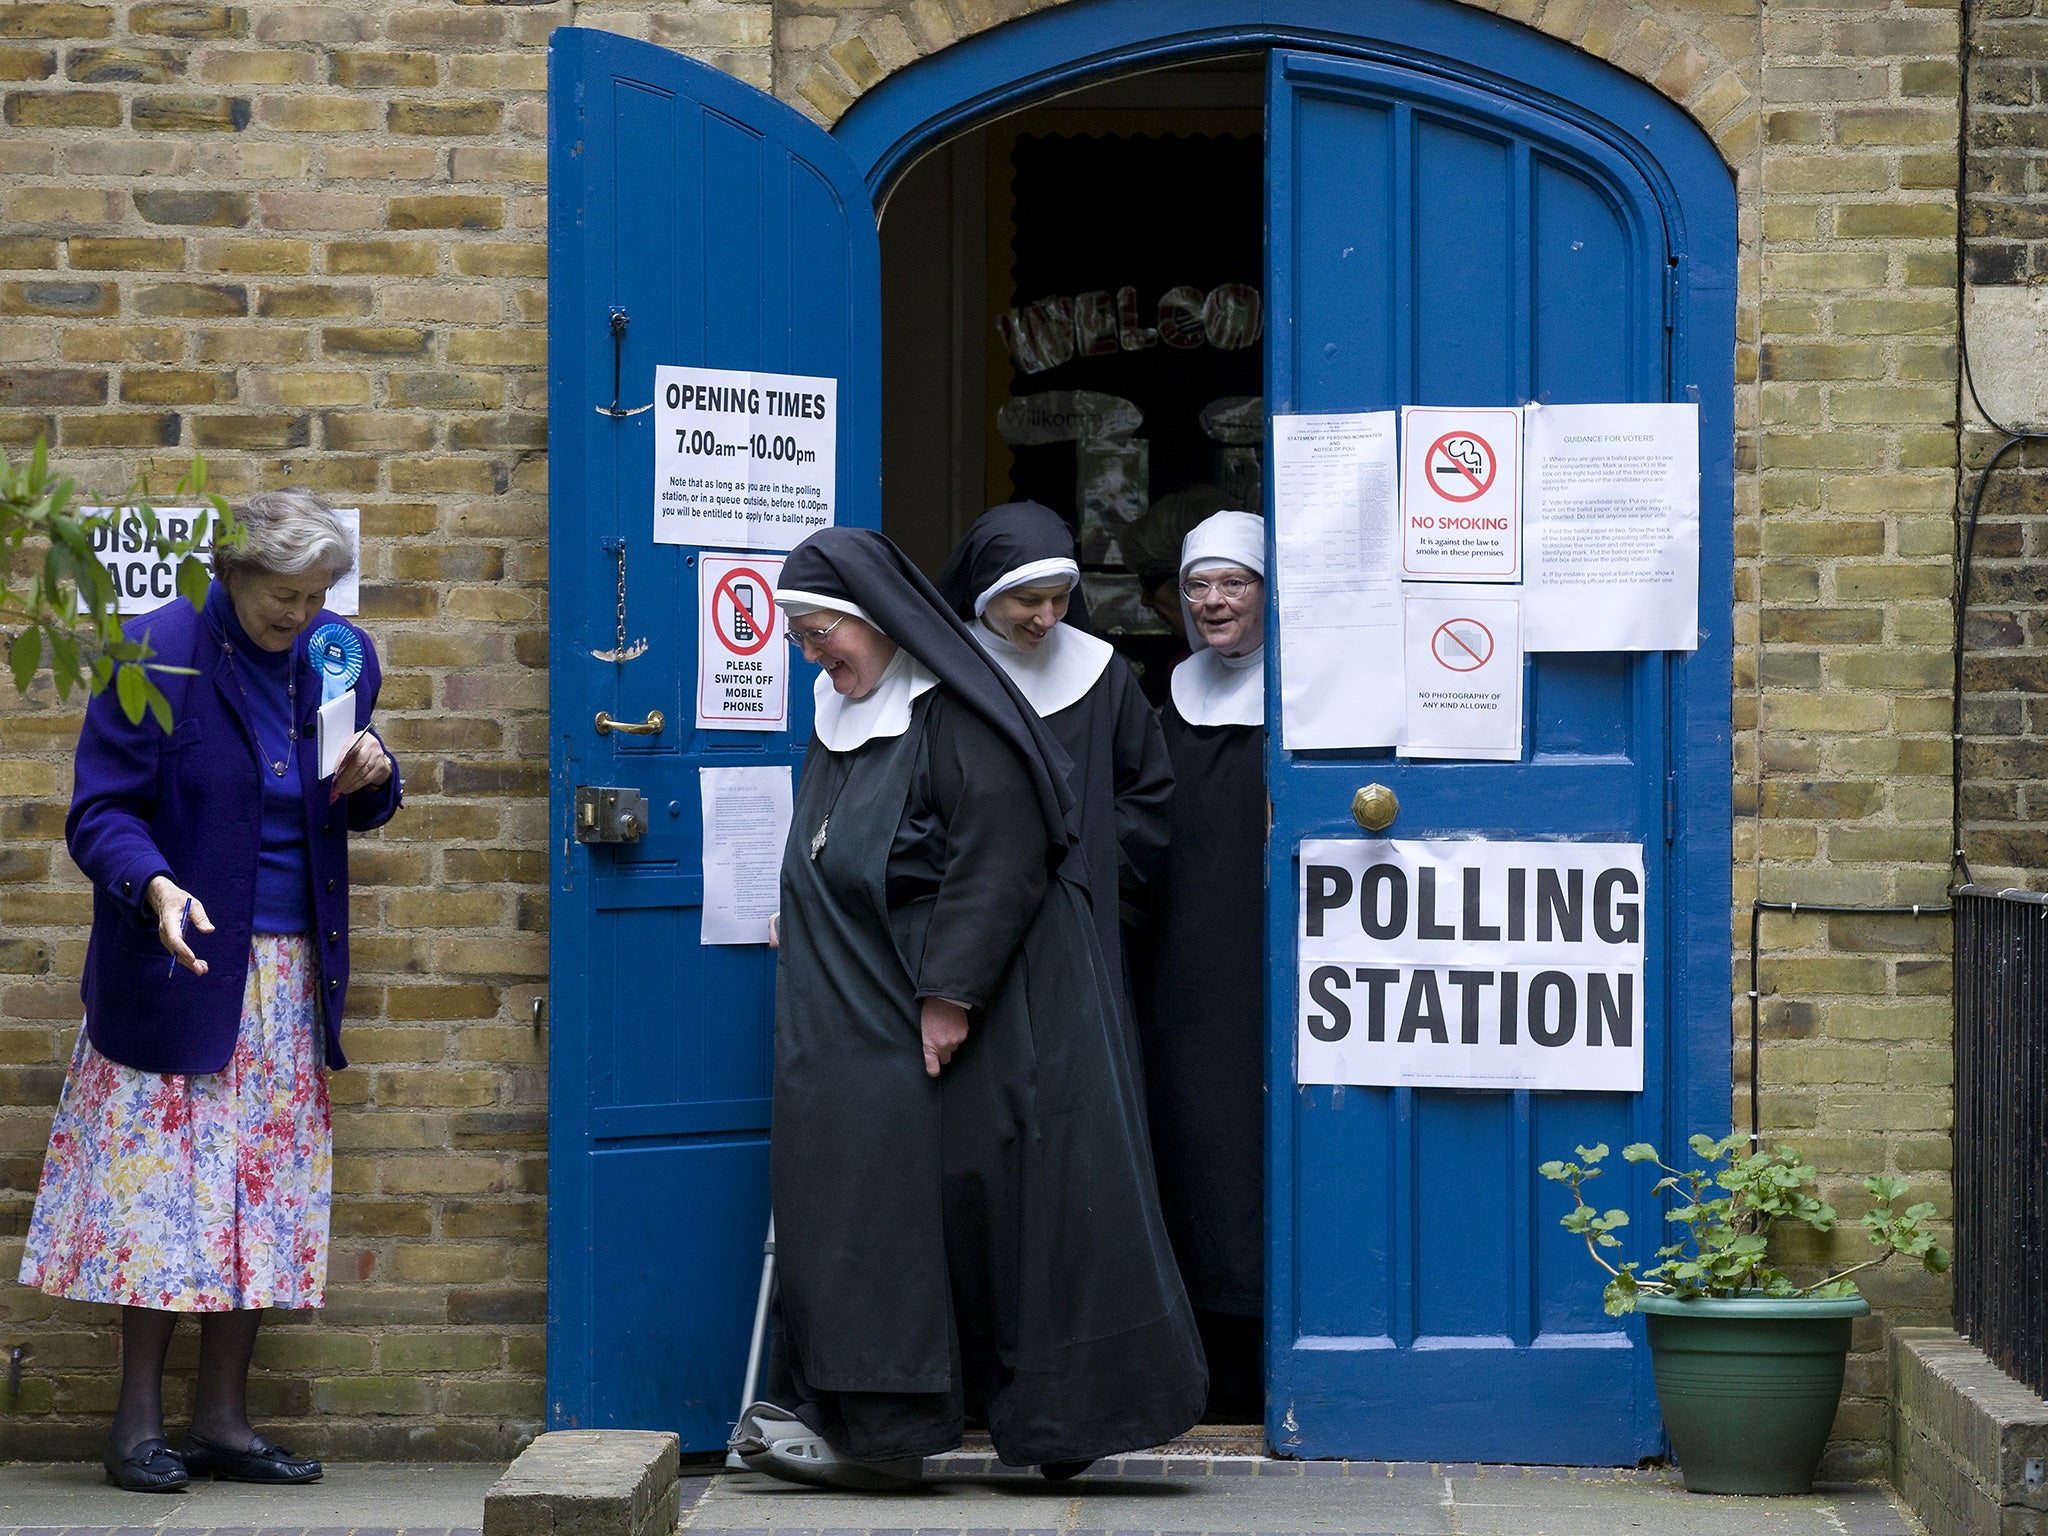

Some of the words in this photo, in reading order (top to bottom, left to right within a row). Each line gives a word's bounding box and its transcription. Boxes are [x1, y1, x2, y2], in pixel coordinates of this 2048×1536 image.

[666, 384, 758, 415] OPENING
[766, 390, 824, 419] TIMES
[670, 477, 686, 487] Note
[688, 478, 702, 488] that
[715, 480, 732, 493] long
[747, 484, 758, 494] you
[772, 483, 779, 493] in
[781, 483, 793, 494] the
[795, 484, 820, 498] polling
[662, 491, 689, 504] station,
[700, 493, 707, 503] in
[715, 496, 740, 507] queue
[744, 495, 769, 509] outside,
[770, 497, 794, 508] before
[797, 498, 827, 512] 10.00pm
[662, 508, 674, 519] you
[676, 507, 690, 517] will
[691, 507, 701, 518] be
[702, 508, 732, 519] entitled
[734, 510, 742, 520] to
[746, 510, 762, 524] apply
[763, 511, 773, 521] for
[782, 512, 803, 523] ballot
[804, 516, 826, 527] paper
[1412, 516, 1434, 528] NO
[1439, 517, 1508, 530] SMOKING
[88, 518, 219, 552] DISABL
[1434, 537, 1460, 547] against
[1471, 548, 1504, 558] premises
[726, 661, 762, 671] PLEASE
[715, 674, 752, 684] SWITCH
[756, 675, 773, 685] OFF
[726, 688, 762, 698] MOBILE
[723, 702, 764, 712] PHONES
[1306, 864, 1639, 944] POLLING
[1307, 965, 1634, 1048] STATION
